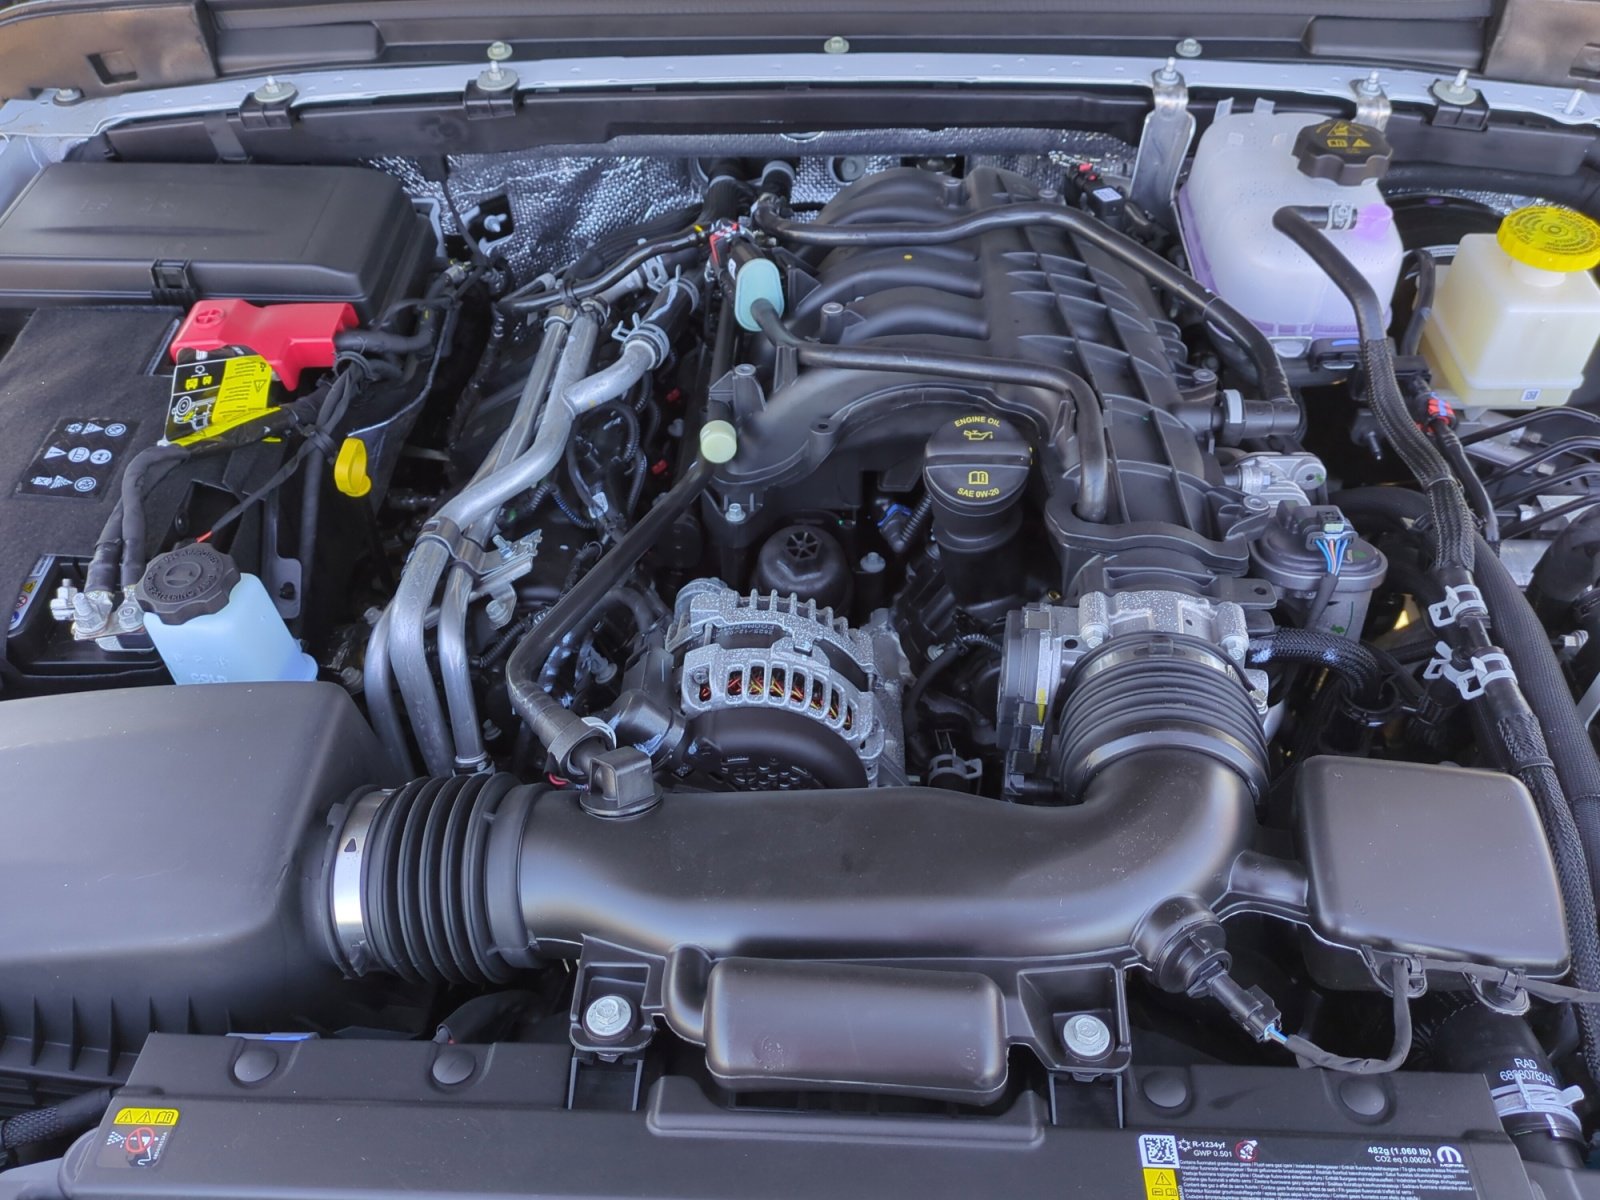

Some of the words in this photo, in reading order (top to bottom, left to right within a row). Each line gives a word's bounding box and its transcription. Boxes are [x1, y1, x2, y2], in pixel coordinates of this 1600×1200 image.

[954, 416, 986, 428] ENGINE
[987, 417, 1001, 428] OIL
[957, 487, 974, 498] SAE
[975, 487, 1000, 498] 0W-20
[1513, 1058, 1538, 1070] RAD
[1192, 1141, 1226, 1150] R-1234yf
[1367, 1146, 1390, 1156] 482g
[1419, 1148, 1432, 1157] lb)
[1374, 1155, 1391, 1163] CO2
[1392, 1157, 1402, 1165] eq
